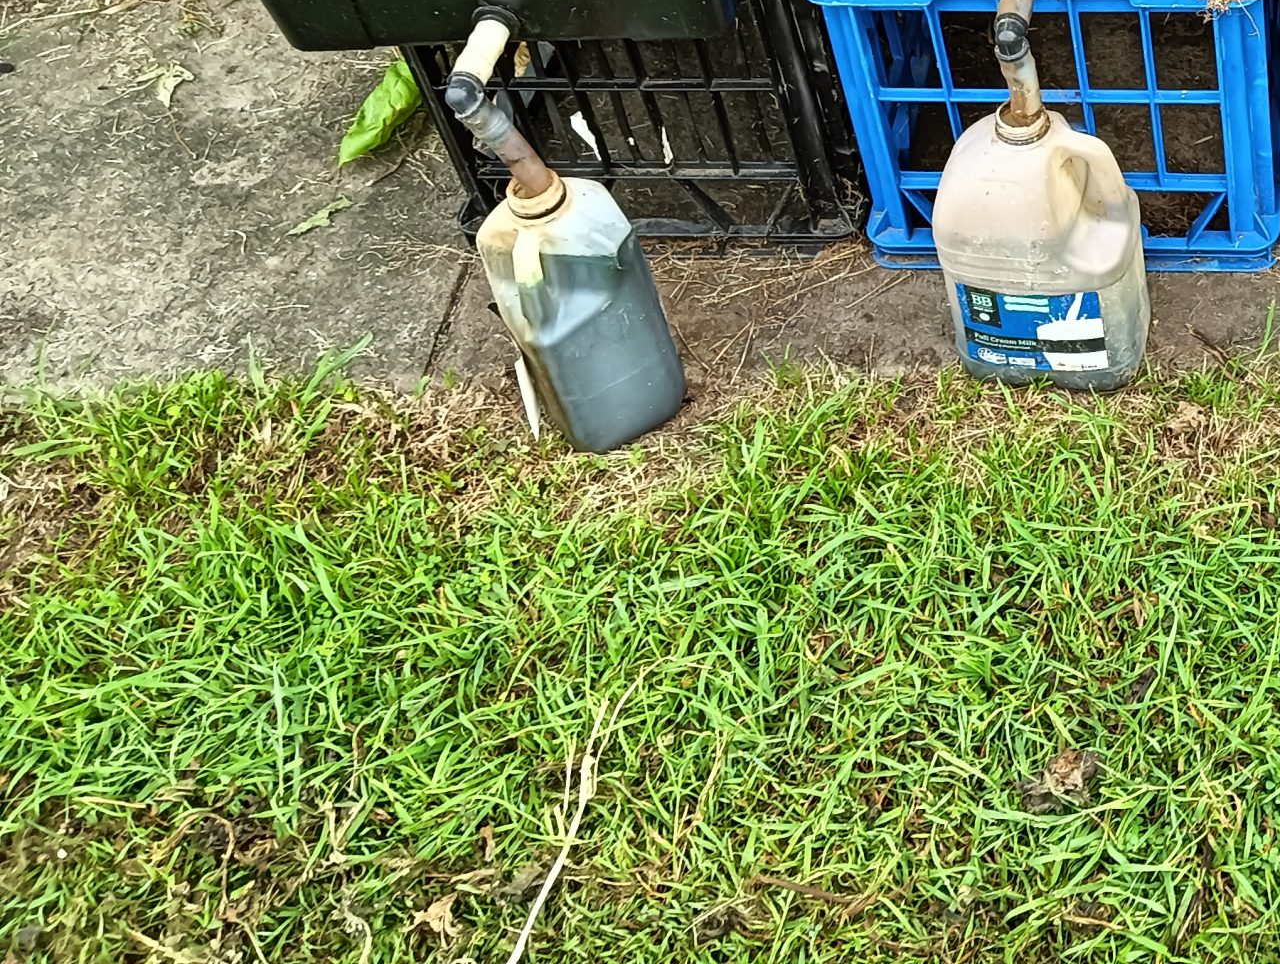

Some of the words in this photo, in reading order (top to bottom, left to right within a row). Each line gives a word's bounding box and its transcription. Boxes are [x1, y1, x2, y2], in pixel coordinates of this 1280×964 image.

[971, 294, 992, 307] BB
[974, 332, 989, 342] Full
[990, 336, 1017, 345] Cream
